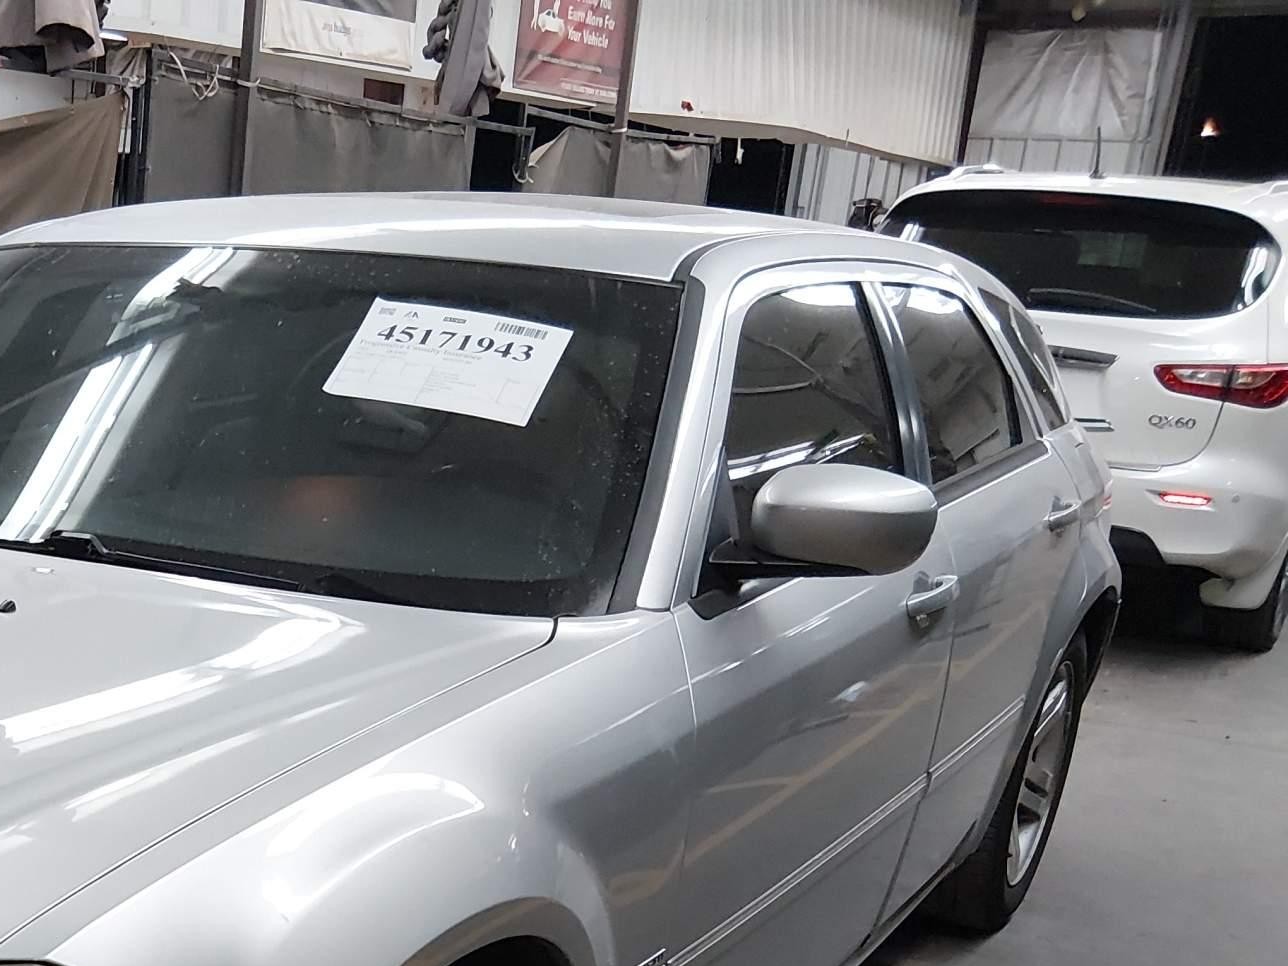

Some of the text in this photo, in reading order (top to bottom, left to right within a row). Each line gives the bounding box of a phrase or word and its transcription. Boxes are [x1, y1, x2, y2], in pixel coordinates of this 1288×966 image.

[568, 6, 616, 31] Earn More For
[568, 25, 609, 49] Your Vehicle
[377, 324, 534, 362] 45171943
[1148, 415, 1197, 430] QX60
